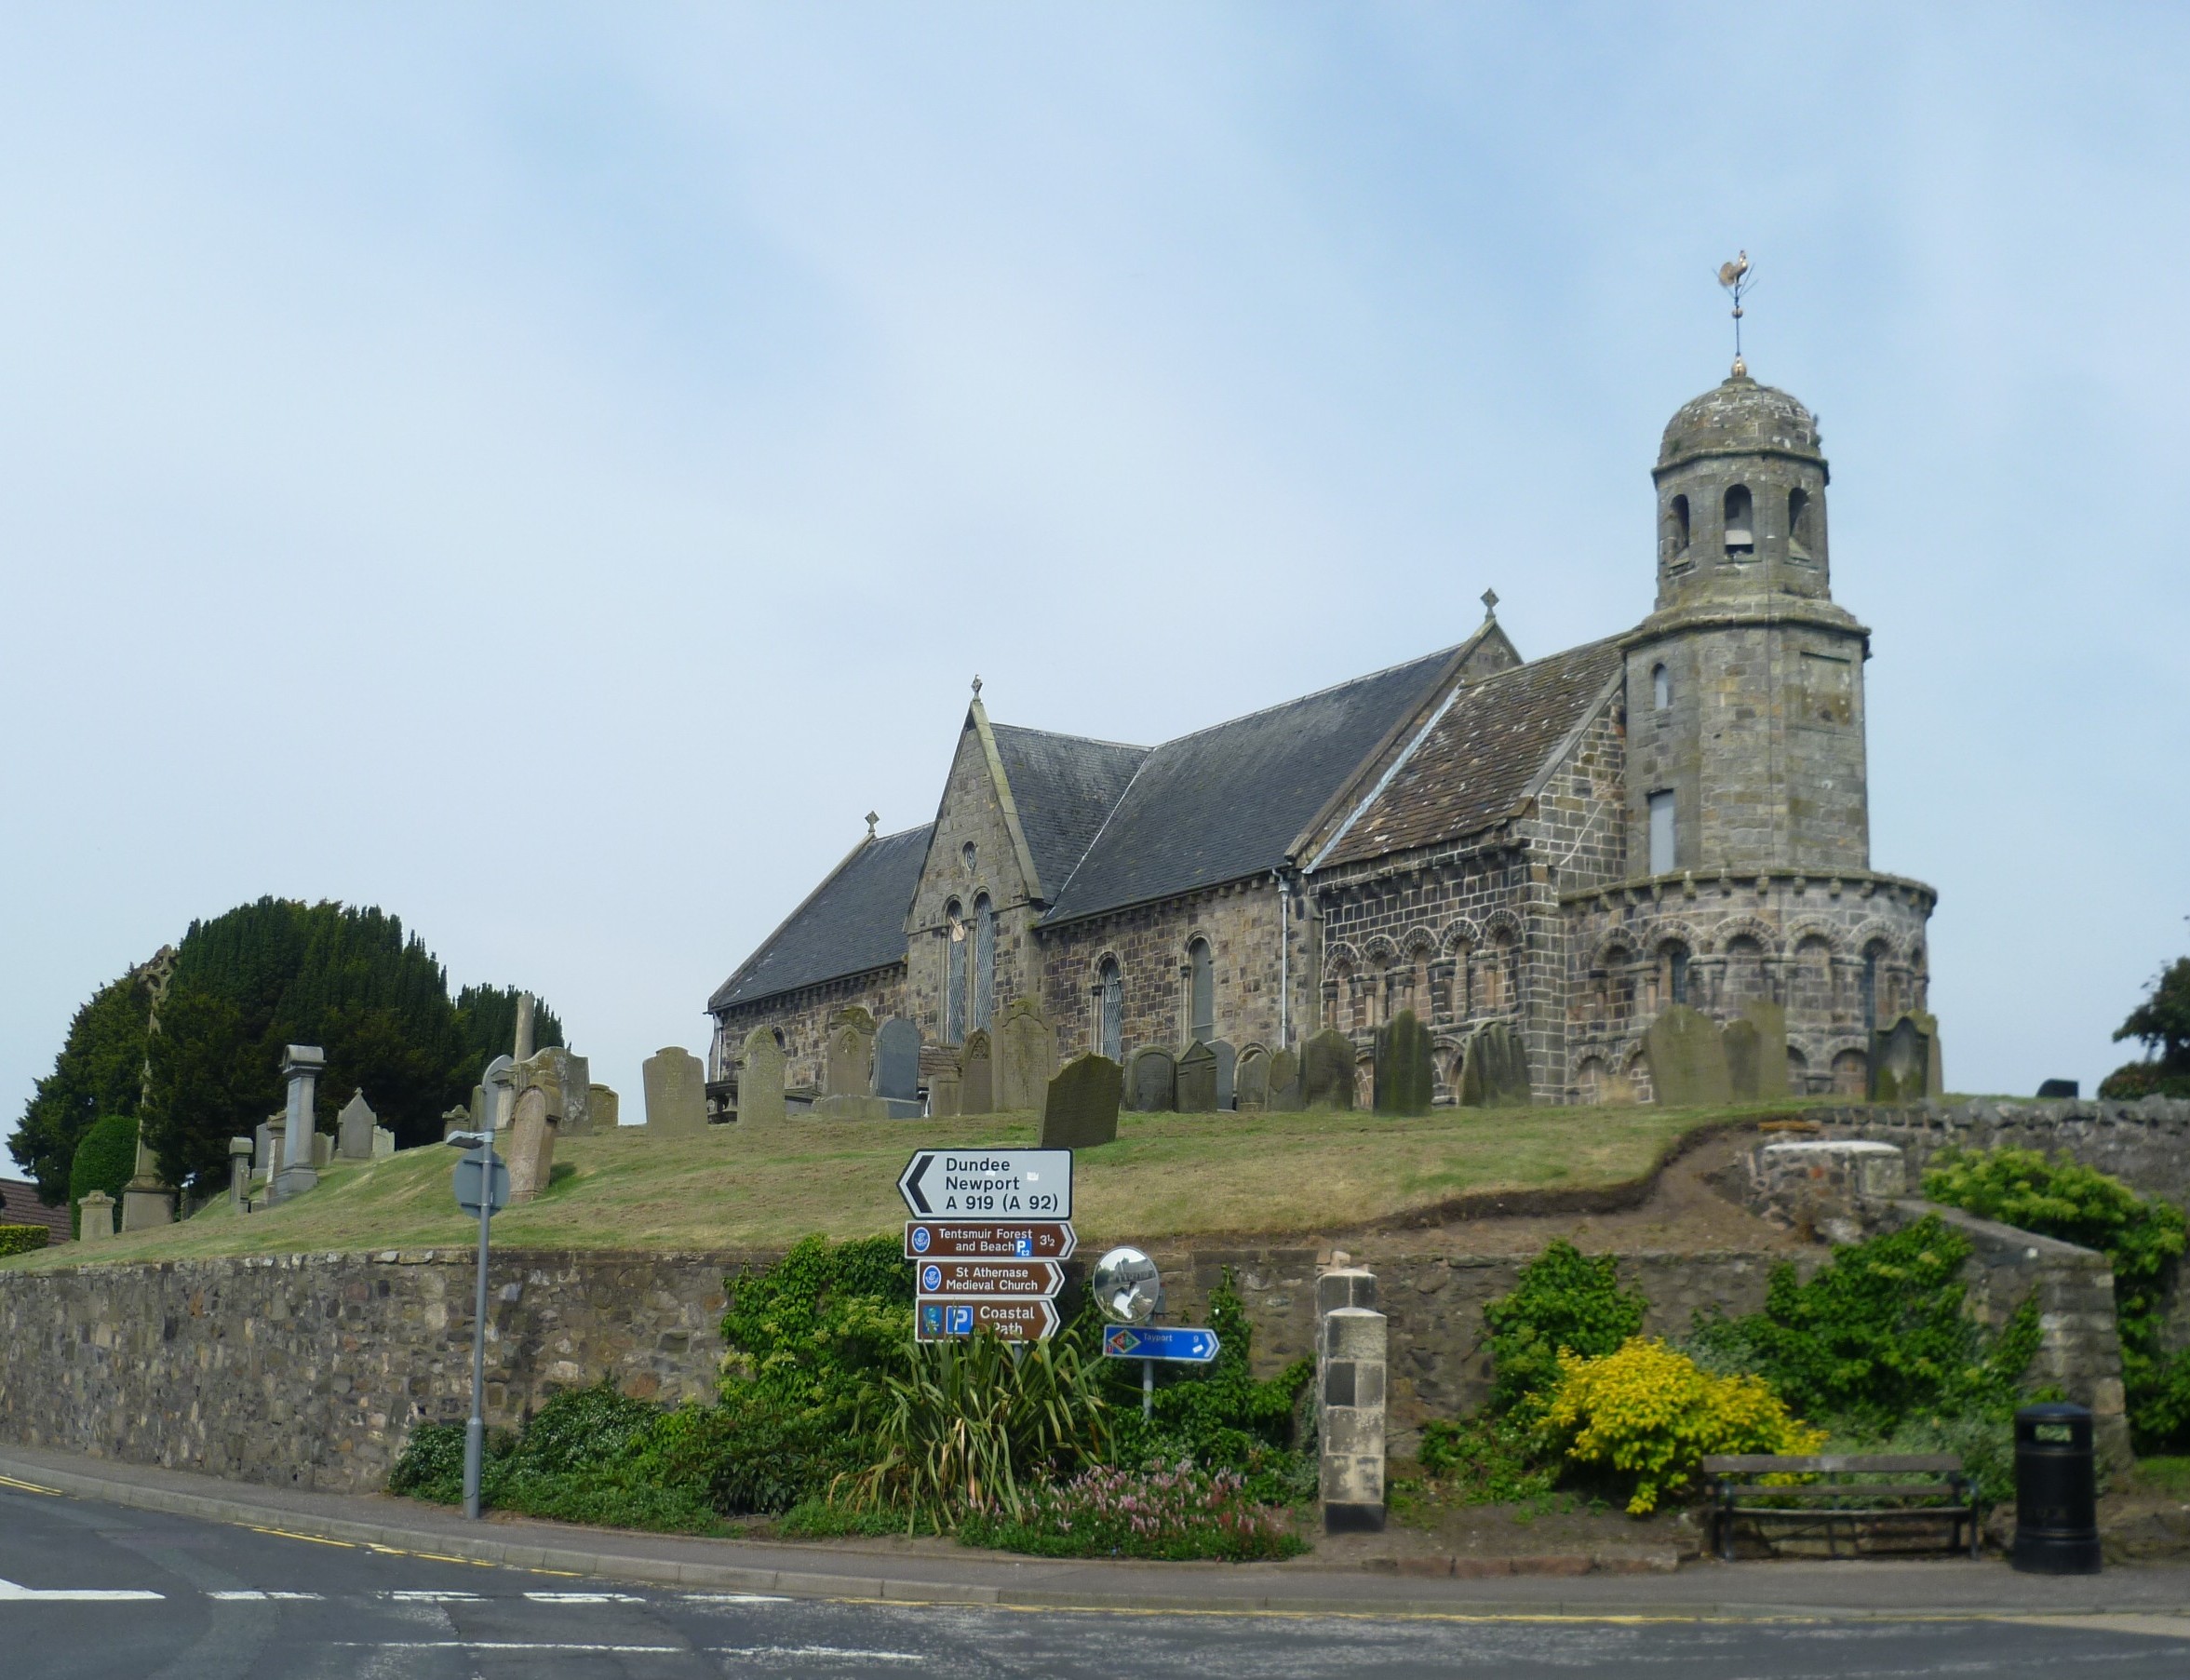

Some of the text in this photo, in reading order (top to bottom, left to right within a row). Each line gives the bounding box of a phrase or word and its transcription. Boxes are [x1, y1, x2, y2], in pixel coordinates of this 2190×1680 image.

[946, 1157, 1011, 1172] Dundee
[946, 1176, 1020, 1192] Newport
[946, 1193, 1058, 1212] A 919 (A 92)
[938, 1228, 1033, 1239] Tentsmuir Forest
[955, 1242, 975, 1252] and
[980, 1242, 1014, 1252] Beach
[956, 1267, 1028, 1278] St Athernase
[946, 1280, 1038, 1291] Medieval Church
[979, 1306, 1035, 1320] Coastal
[1144, 1333, 1173, 1343] Tayport
